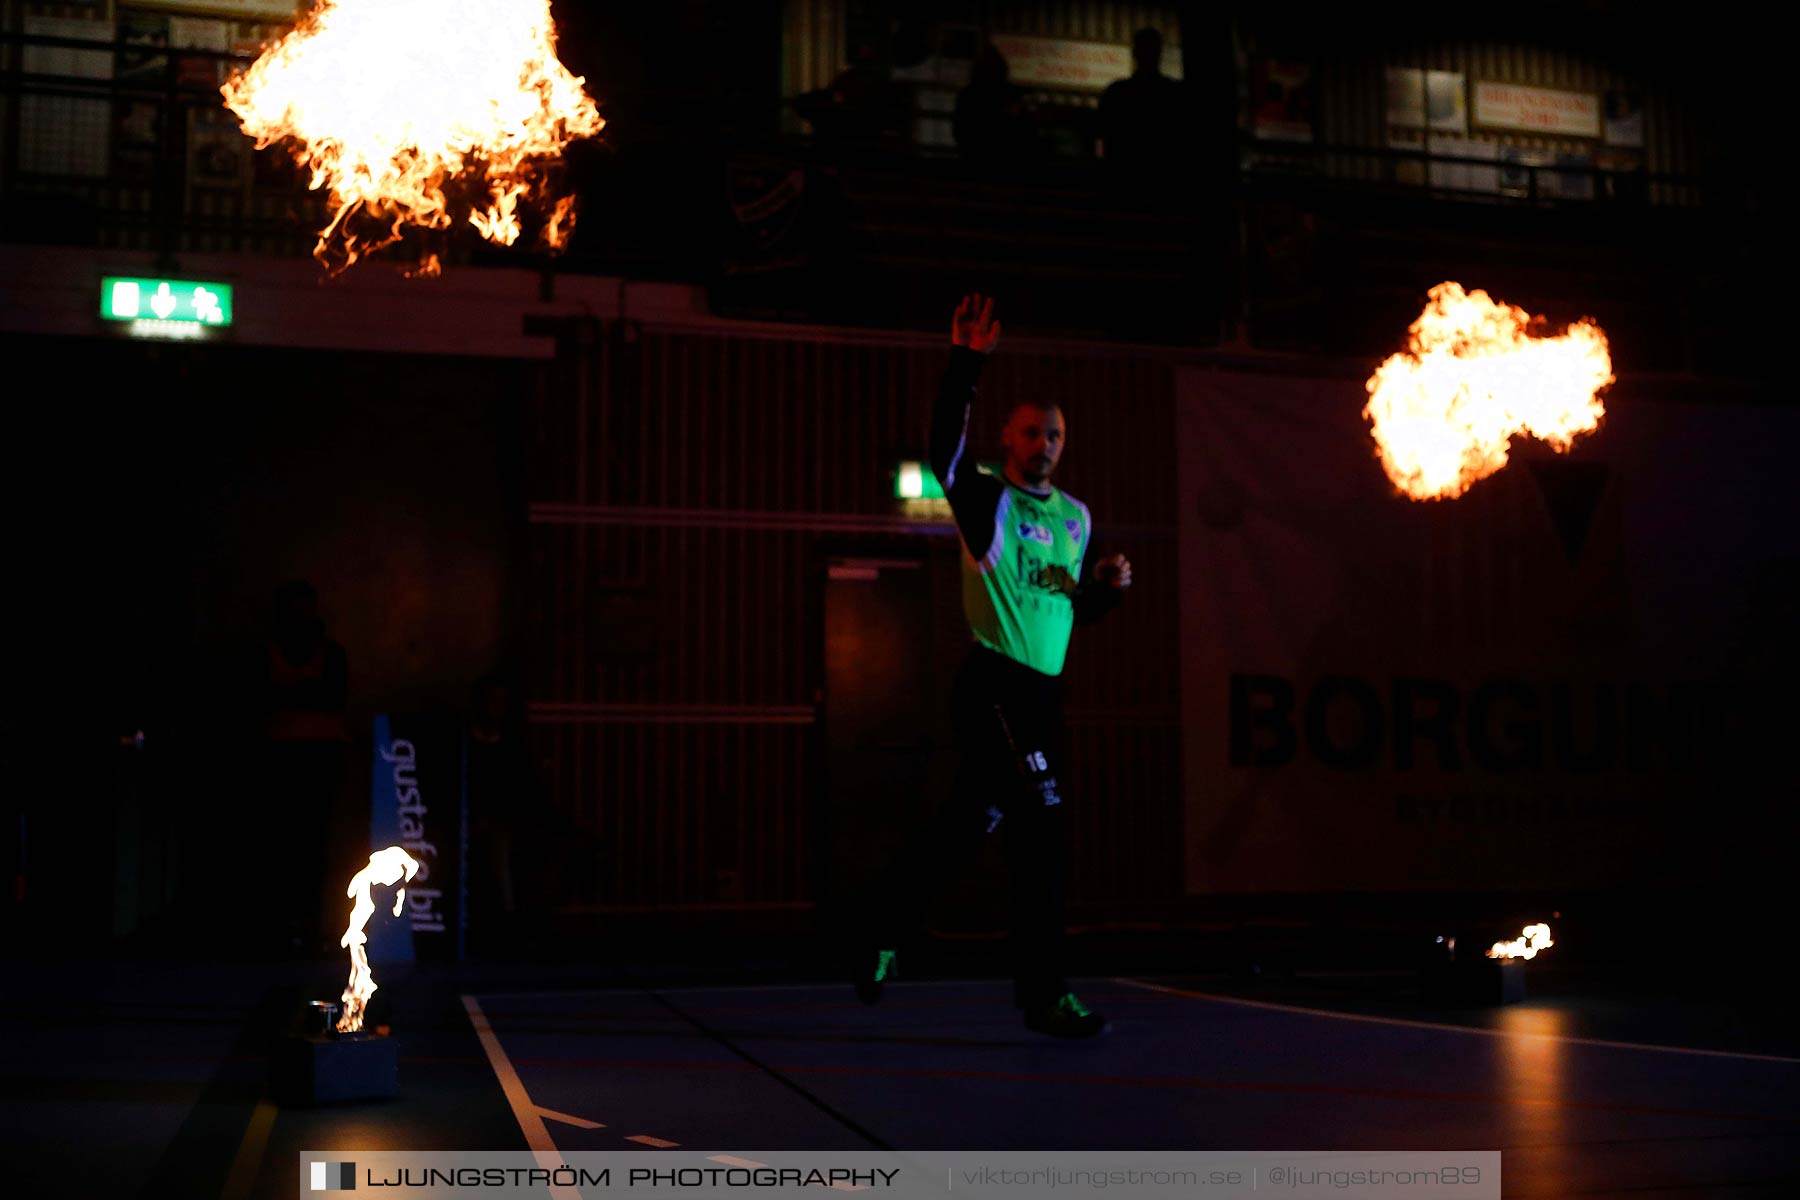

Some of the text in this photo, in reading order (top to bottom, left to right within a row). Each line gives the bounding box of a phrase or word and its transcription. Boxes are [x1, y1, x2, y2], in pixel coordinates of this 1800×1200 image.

[1025, 750, 1048, 773] 16
[380, 738, 438, 859] gustaf
[407, 888, 446, 932] bil
